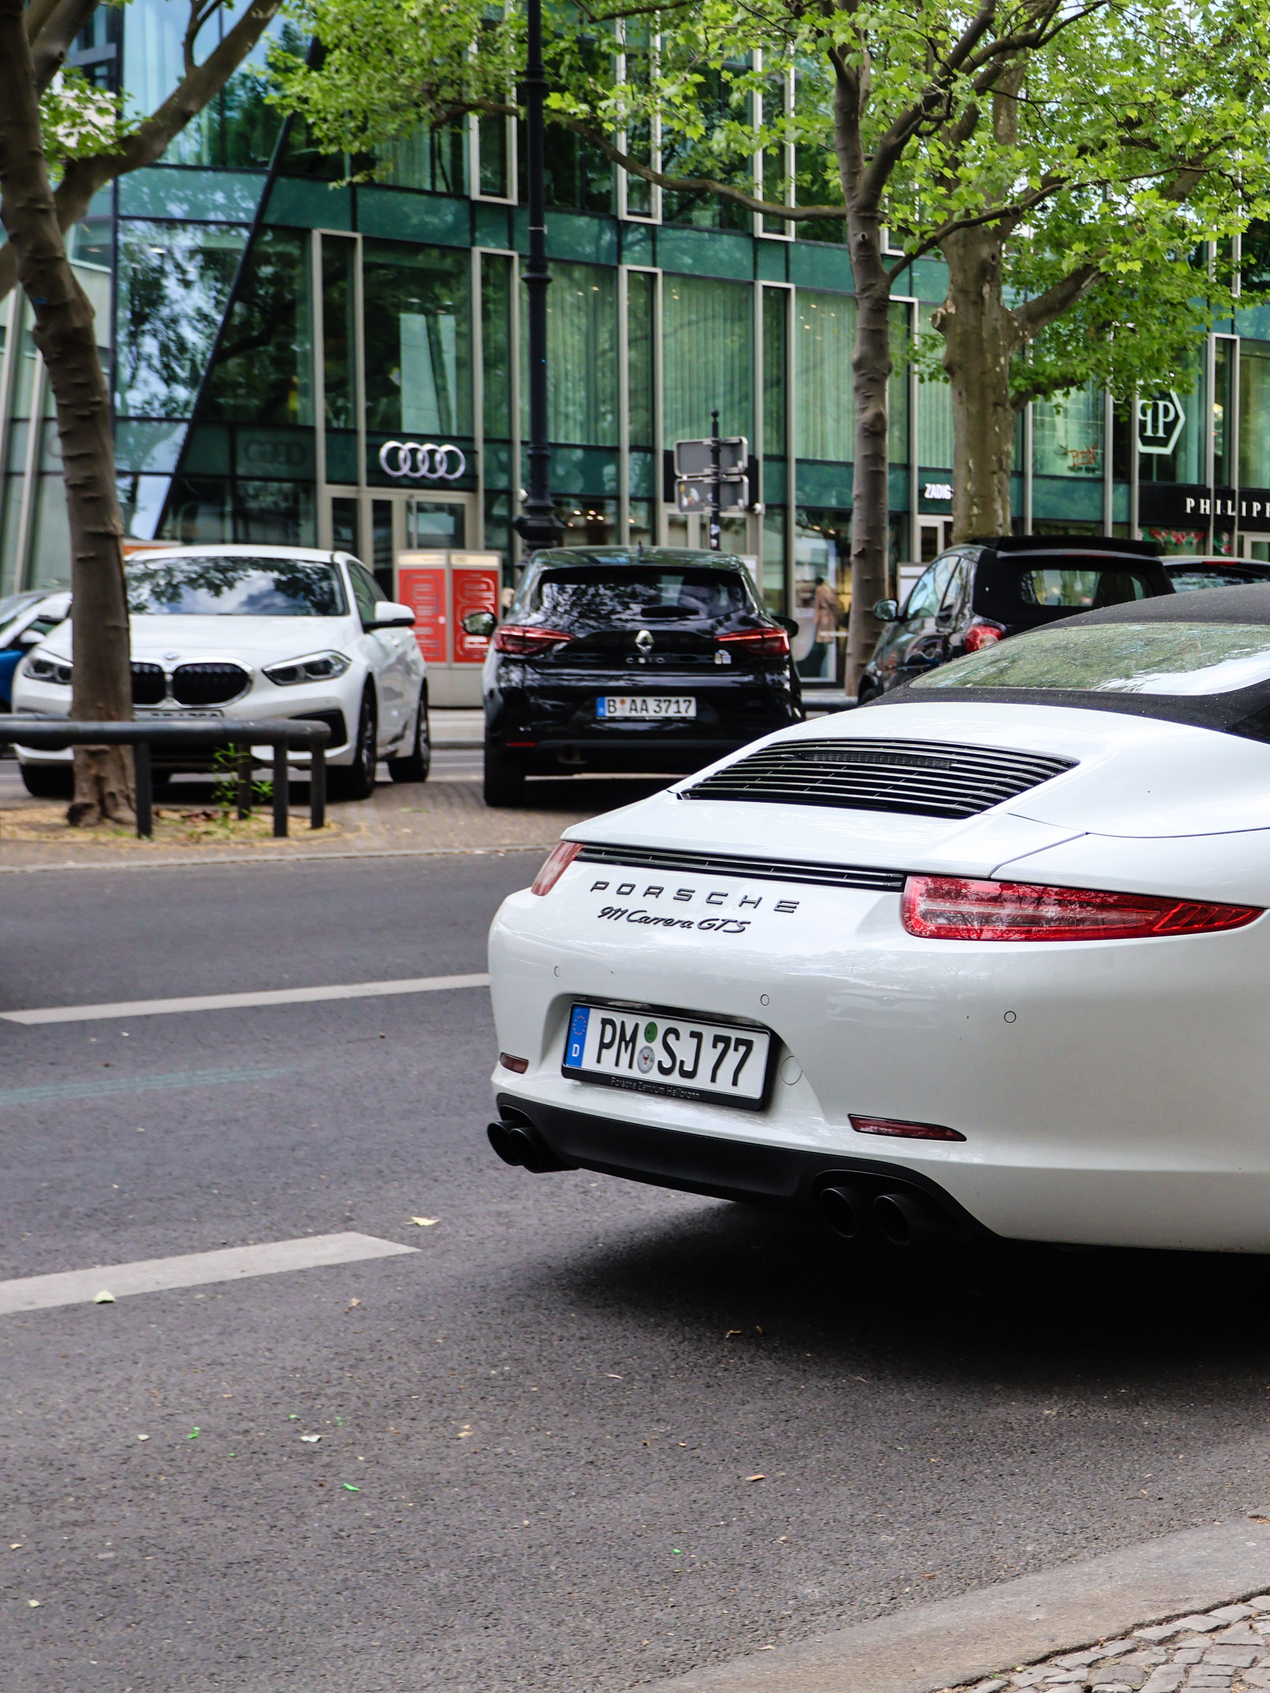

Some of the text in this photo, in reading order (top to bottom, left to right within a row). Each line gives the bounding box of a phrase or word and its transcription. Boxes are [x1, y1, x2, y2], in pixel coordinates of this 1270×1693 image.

[607, 699, 693, 714] B AA 3717
[590, 880, 800, 914] PORSCHE
[597, 906, 752, 933] 911 Carrera GTS
[571, 1043, 580, 1058] D
[596, 1017, 754, 1087] PM SJ 77
[611, 1076, 636, 1090] Porsche
[638, 1081, 665, 1095] Zentrum
